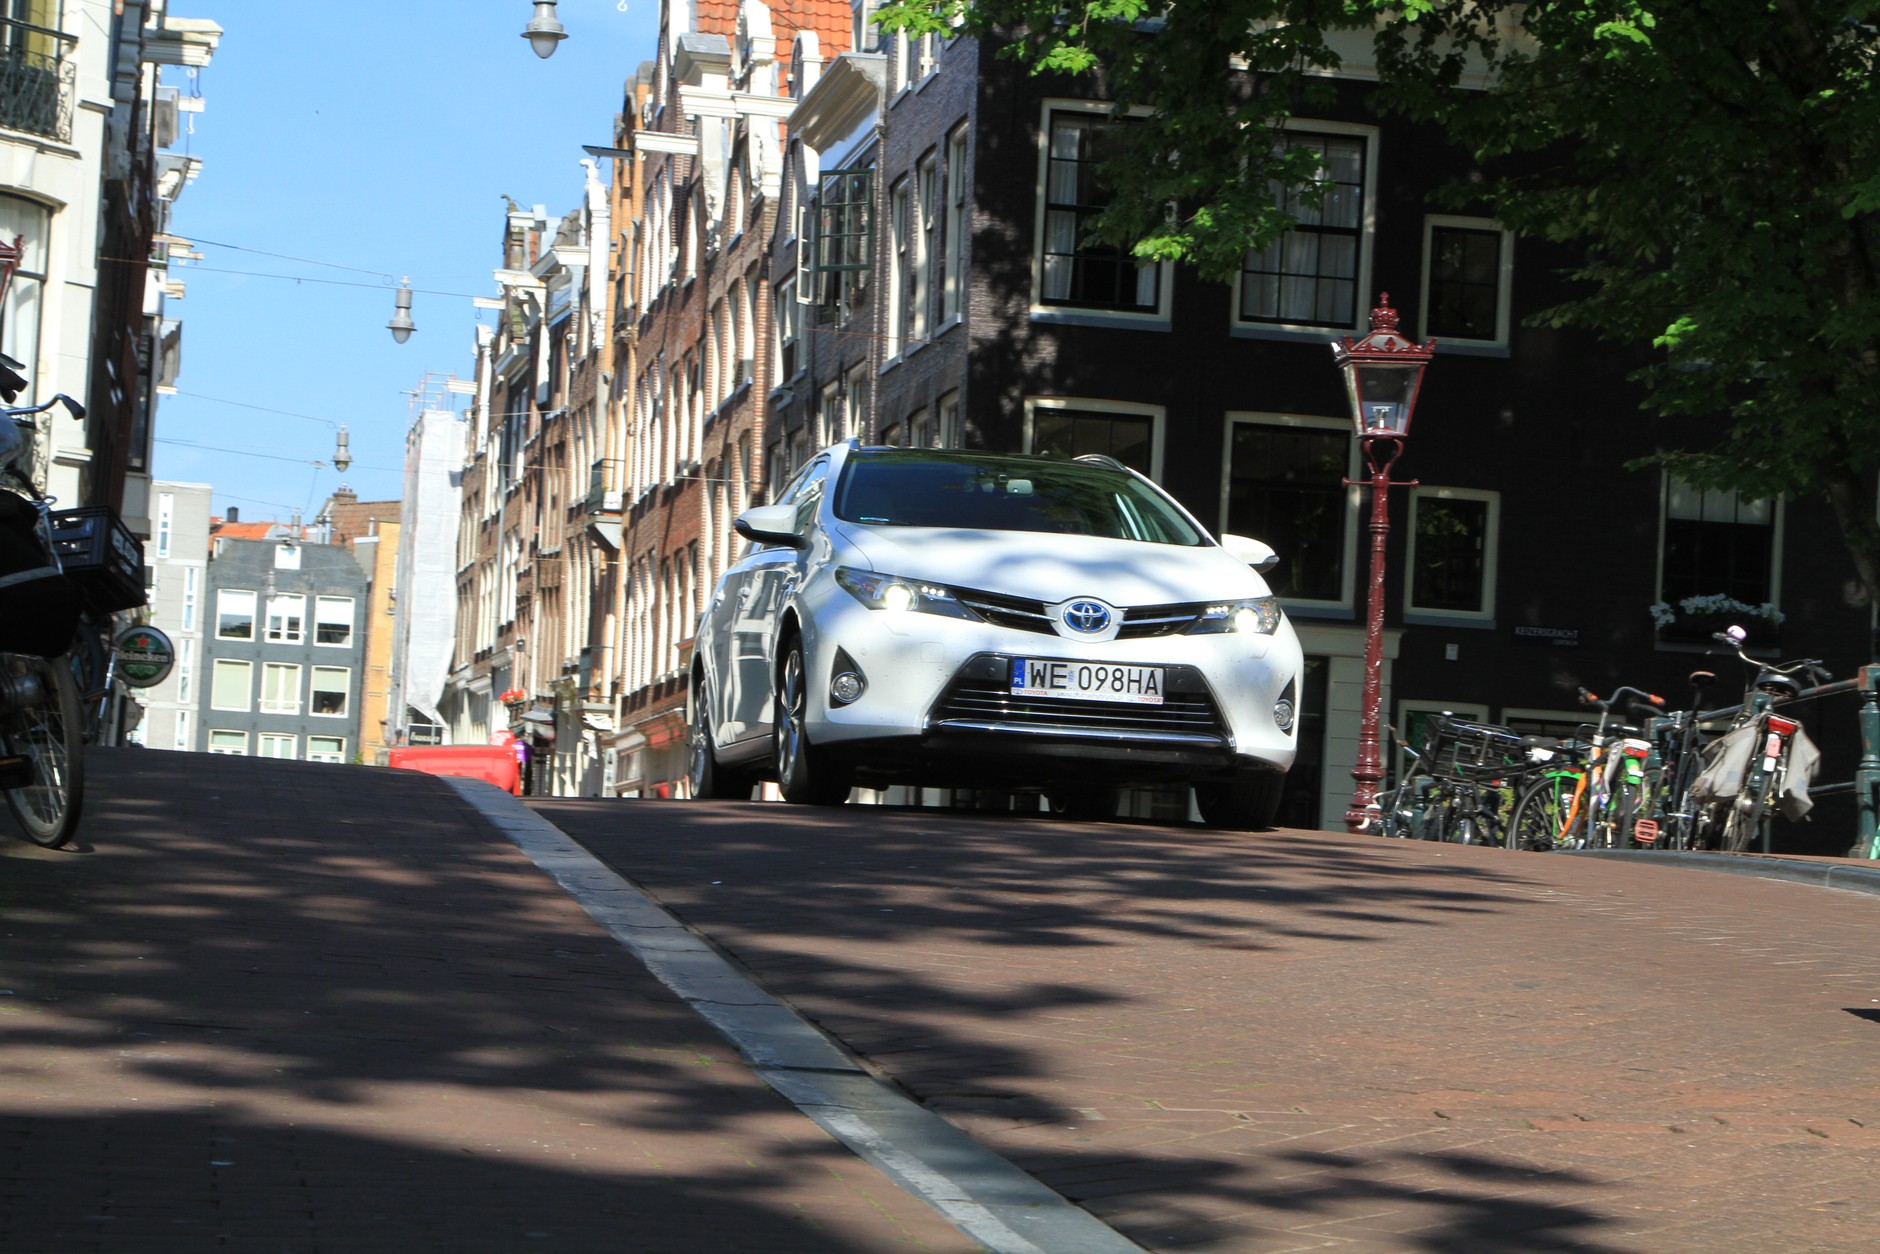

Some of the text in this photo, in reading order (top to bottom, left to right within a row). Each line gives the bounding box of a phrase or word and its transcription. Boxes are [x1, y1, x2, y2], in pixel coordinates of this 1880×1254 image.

[1515, 626, 1579, 638] KEIZERSGRACHT
[1013, 677, 1024, 686] PL
[1030, 662, 1159, 695] WE 098HA
